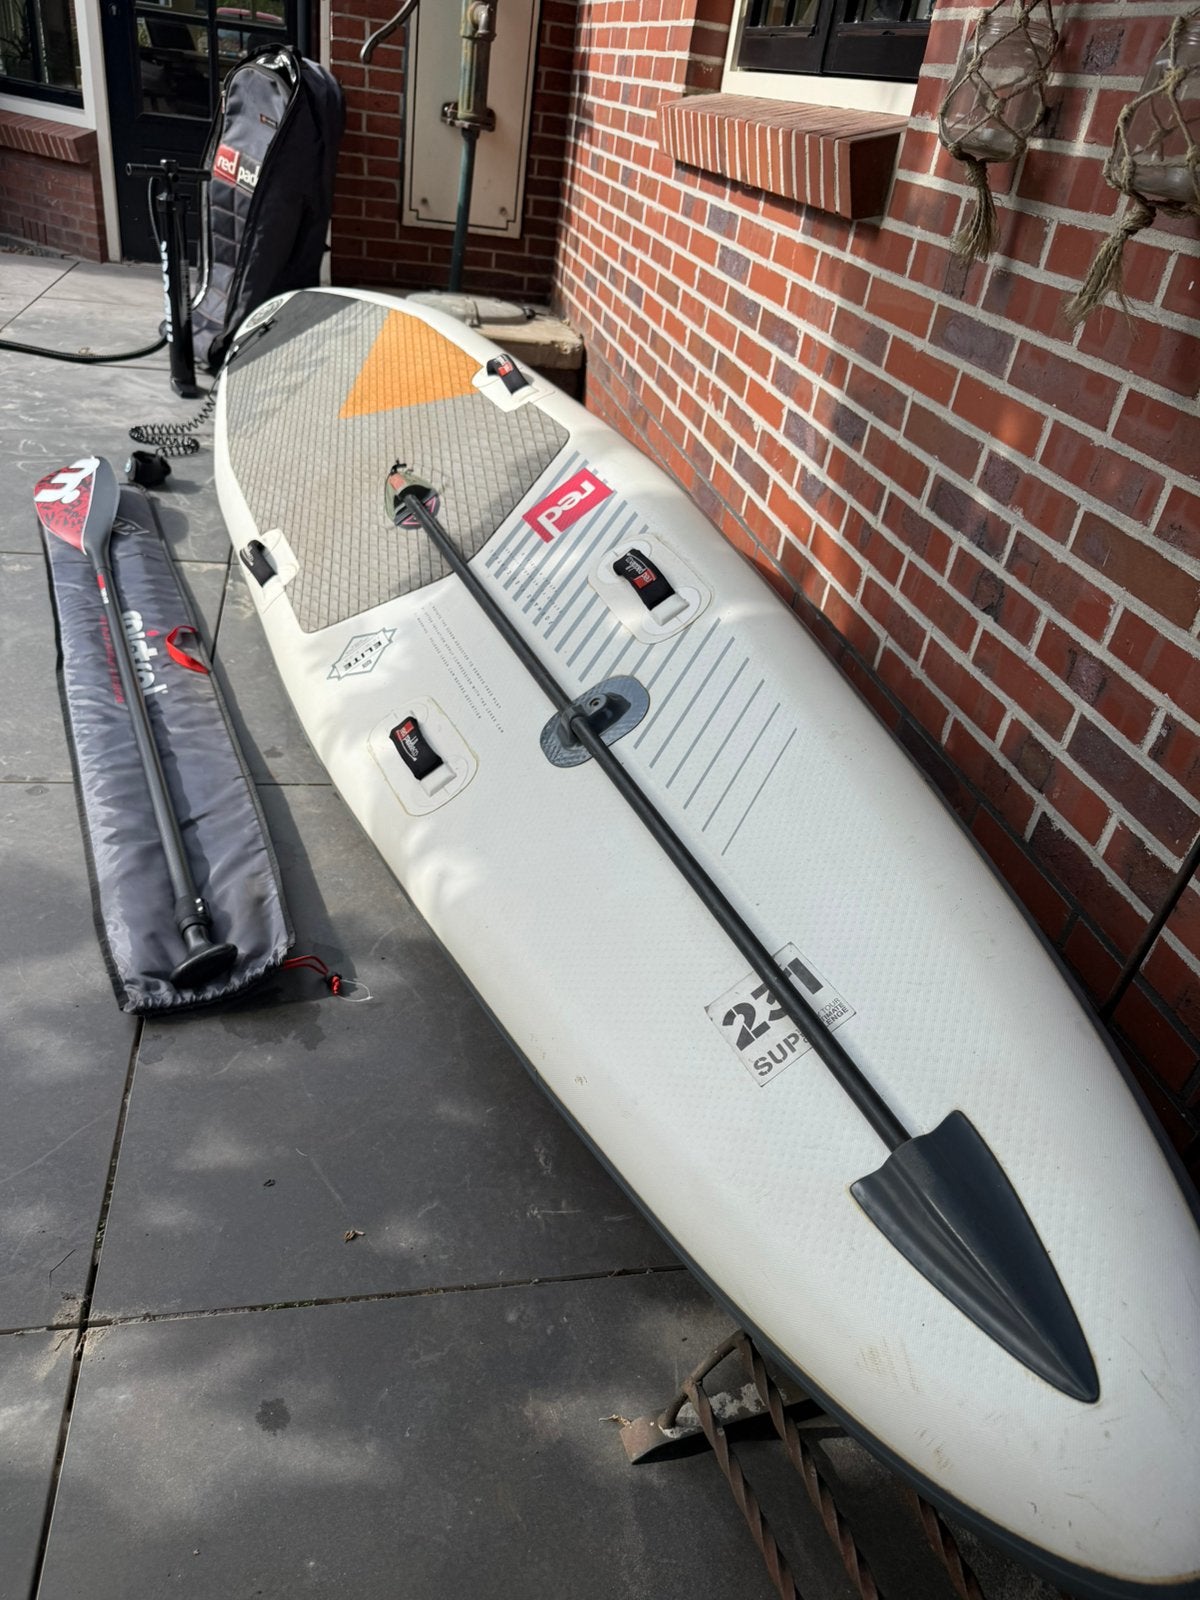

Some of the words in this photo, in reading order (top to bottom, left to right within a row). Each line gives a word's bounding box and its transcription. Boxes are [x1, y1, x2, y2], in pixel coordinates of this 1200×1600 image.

[217, 150, 240, 175] red
[537, 480, 596, 539] red
[343, 640, 381, 670] ELITE
[819, 997, 841, 1014] TOUR
[753, 1032, 800, 1076] SUP
